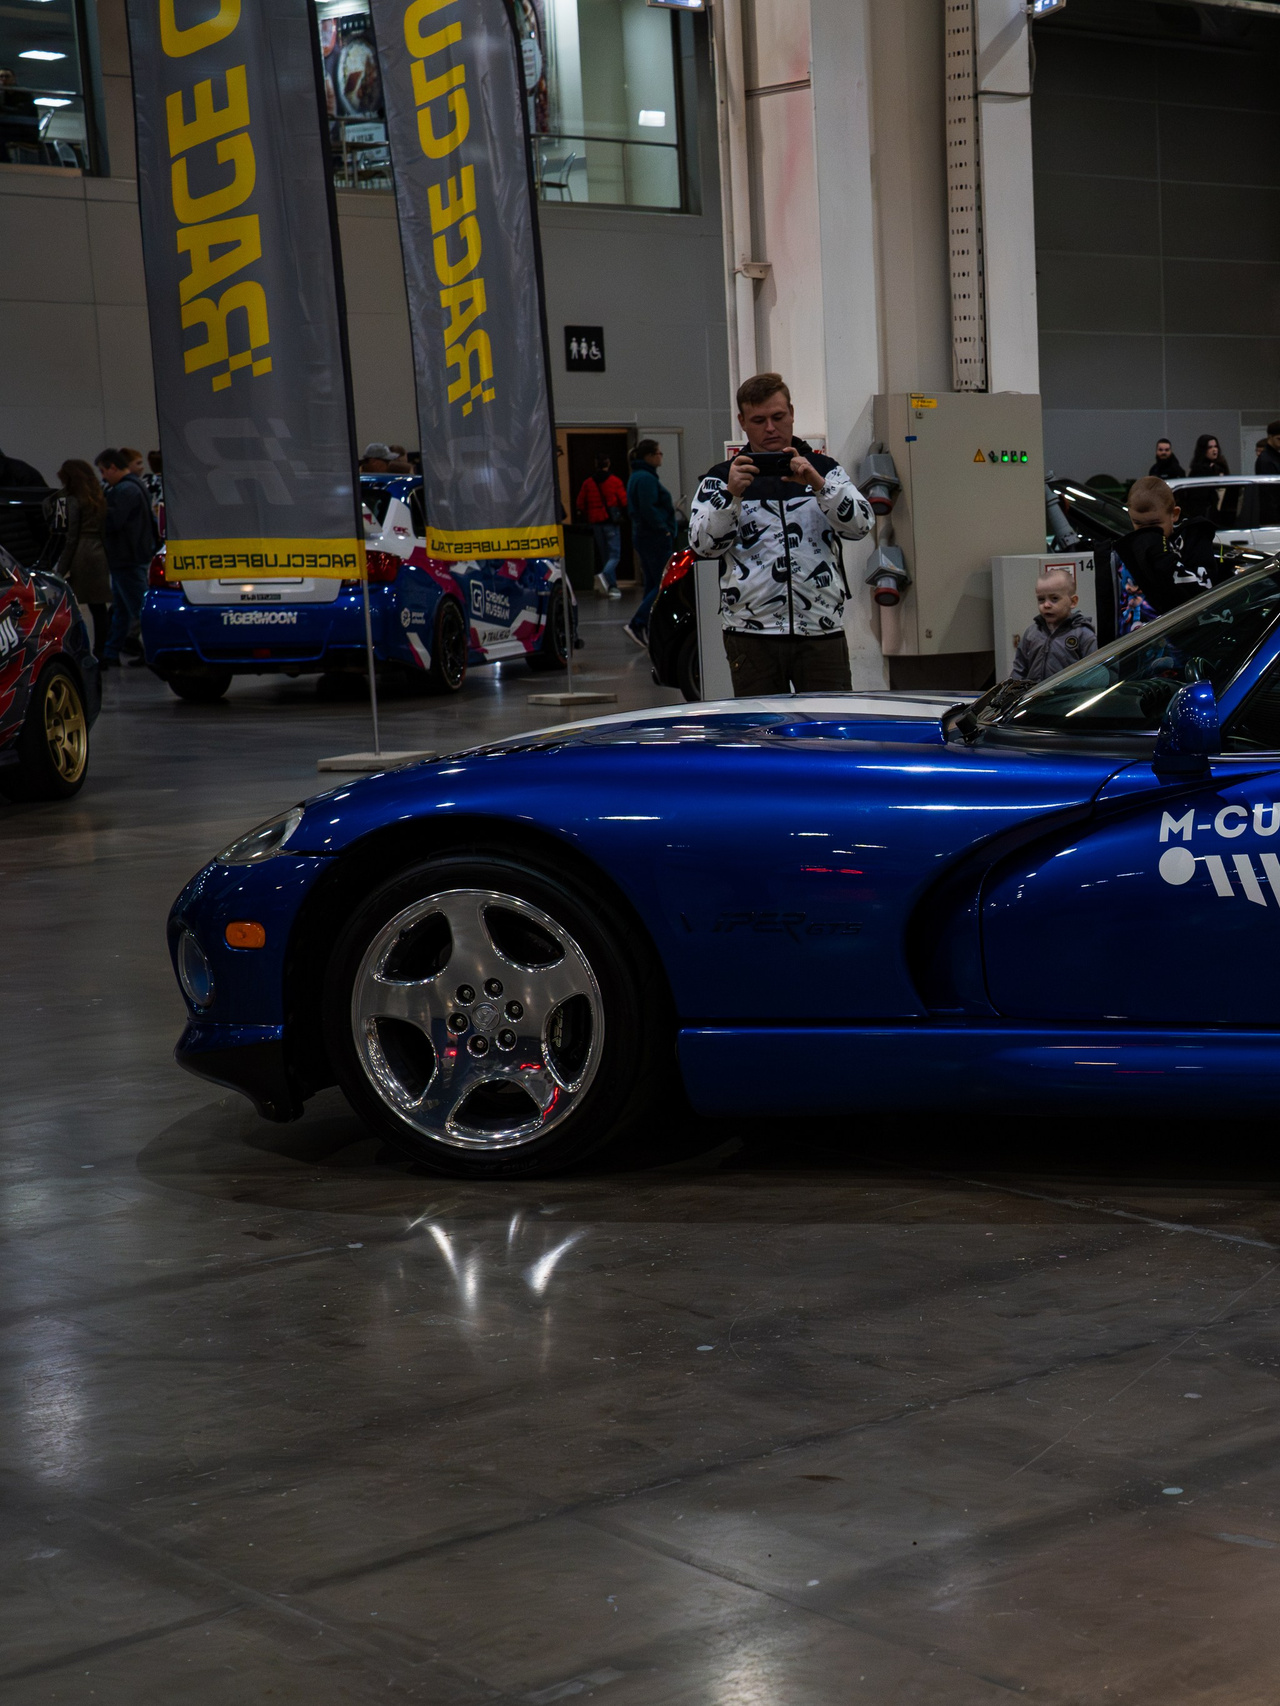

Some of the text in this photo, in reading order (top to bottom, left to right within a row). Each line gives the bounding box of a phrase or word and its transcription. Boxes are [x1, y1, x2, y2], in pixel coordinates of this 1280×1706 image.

[837, 496, 852, 514] NIKE
[741, 520, 759, 537] NIKE
[1078, 560, 1094, 572] 14
